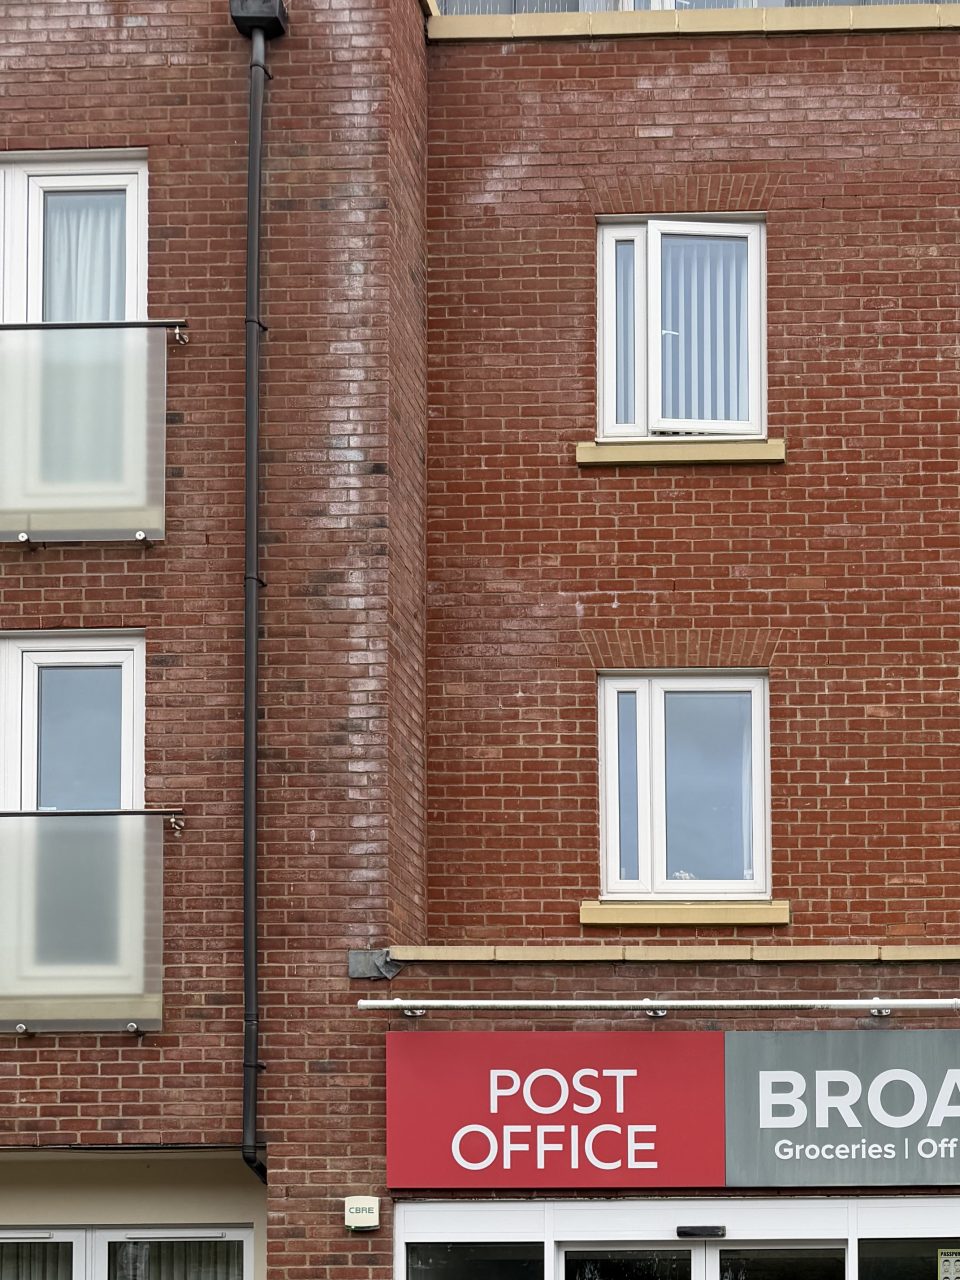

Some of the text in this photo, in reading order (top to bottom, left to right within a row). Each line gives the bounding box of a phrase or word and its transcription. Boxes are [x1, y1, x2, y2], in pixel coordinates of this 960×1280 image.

[489, 1068, 637, 1115] POST
[451, 1124, 658, 1171] OFFICE
[774, 1138, 896, 1161] Groceries
[917, 1136, 957, 1160] Off
